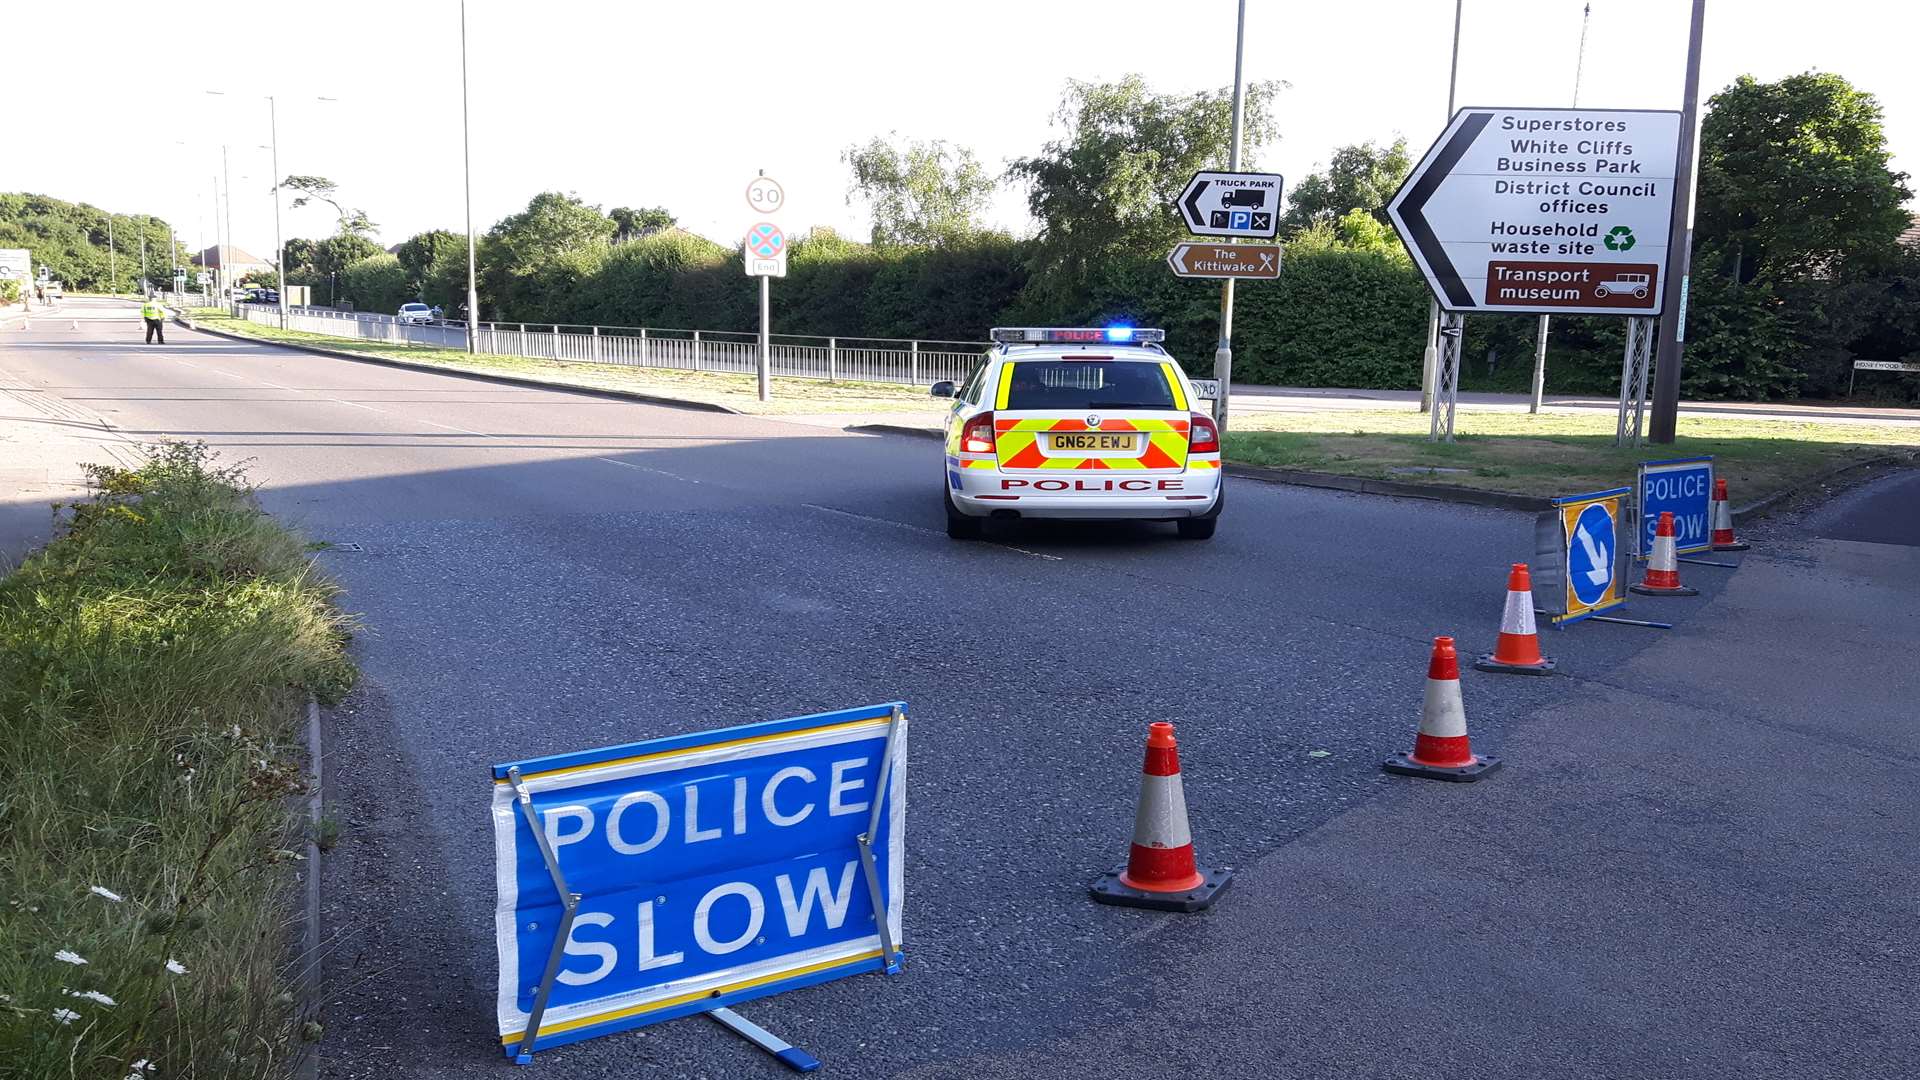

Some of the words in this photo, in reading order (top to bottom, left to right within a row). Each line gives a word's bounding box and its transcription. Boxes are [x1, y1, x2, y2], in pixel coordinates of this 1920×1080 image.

[1501, 116, 1627, 133] Superstores
[1510, 139, 1569, 155] White
[1577, 140, 1633, 156] Cliffs
[1497, 158, 1587, 173] Business
[1595, 160, 1642, 174] Park
[752, 188, 779, 203] 30
[1495, 180, 1570, 196] District
[1578, 182, 1657, 197] Council
[1539, 200, 1609, 214] offices
[1234, 213, 1247, 228] P
[1490, 221, 1599, 237] Household
[1214, 249, 1236, 259] The
[1491, 242, 1551, 255] waste
[1558, 241, 1595, 255] site
[1194, 260, 1255, 272] Kittiwake
[1495, 266, 1590, 284] Transport
[1500, 287, 1580, 300] museum
[1055, 330, 1103, 340] POLICE
[1055, 435, 1096, 449] GN62
[1100, 436, 1131, 449] EWJ
[1001, 479, 1185, 491] POLICE
[1645, 475, 1705, 501] POLICE
[1646, 513, 1704, 546] SOW
[543, 757, 870, 871] POLICE
[555, 860, 859, 987] SLOW
